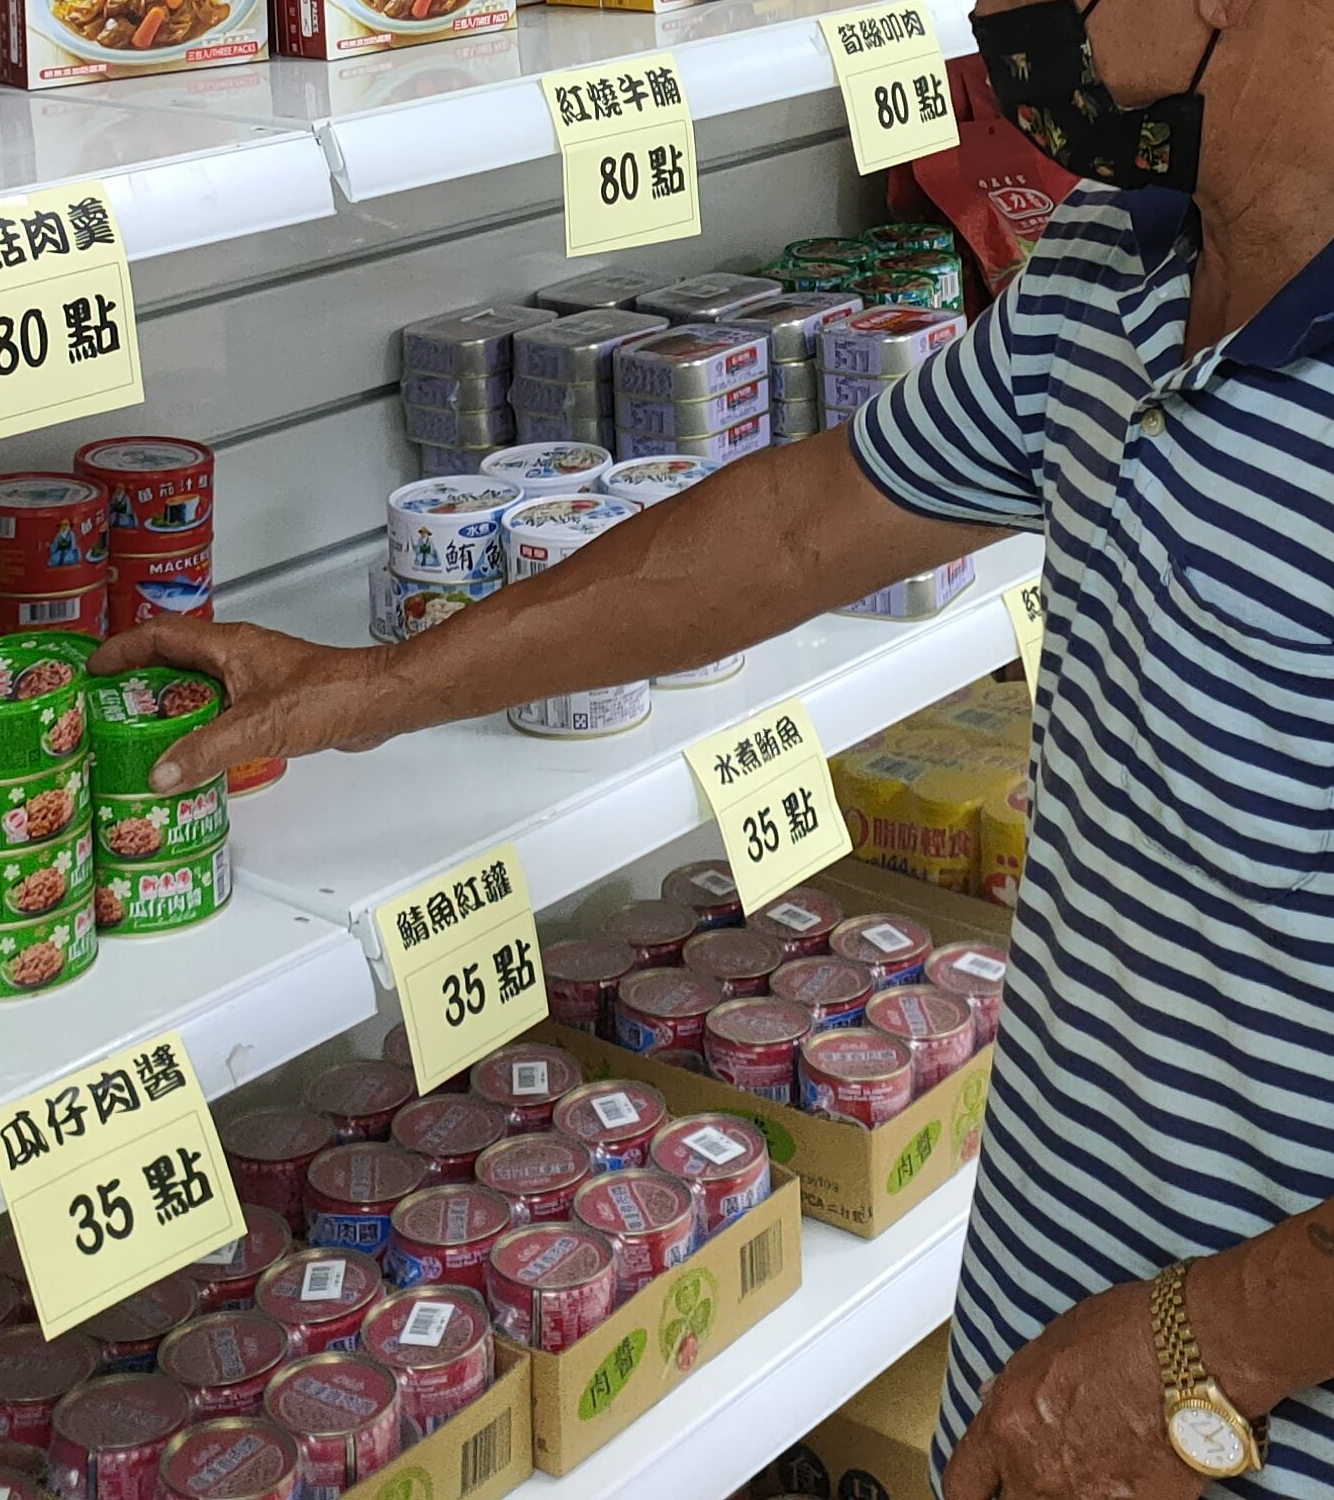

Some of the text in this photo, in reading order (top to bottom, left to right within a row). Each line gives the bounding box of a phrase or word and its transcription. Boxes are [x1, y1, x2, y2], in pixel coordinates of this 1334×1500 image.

[838, 9, 927, 55] 筍絲叩肉
[555, 67, 682, 127] 紅燒牛腩
[874, 73, 948, 130] 80 點
[600, 144, 686, 206] 80 點
[62, 294, 121, 364] 點
[445, 538, 503, 574] 鮪魚
[713, 715, 803, 786] 水煮鮪魚
[742, 806, 780, 863] 35
[784, 787, 819, 845] 點
[396, 860, 513, 951] 鯖魚紅罐
[441, 938, 536, 1028] 35 點
[0, 1043, 187, 1170] 瓜仔肉醬
[69, 1147, 215, 1257] 35 點
[591, 1336, 635, 1409] 肉醬
